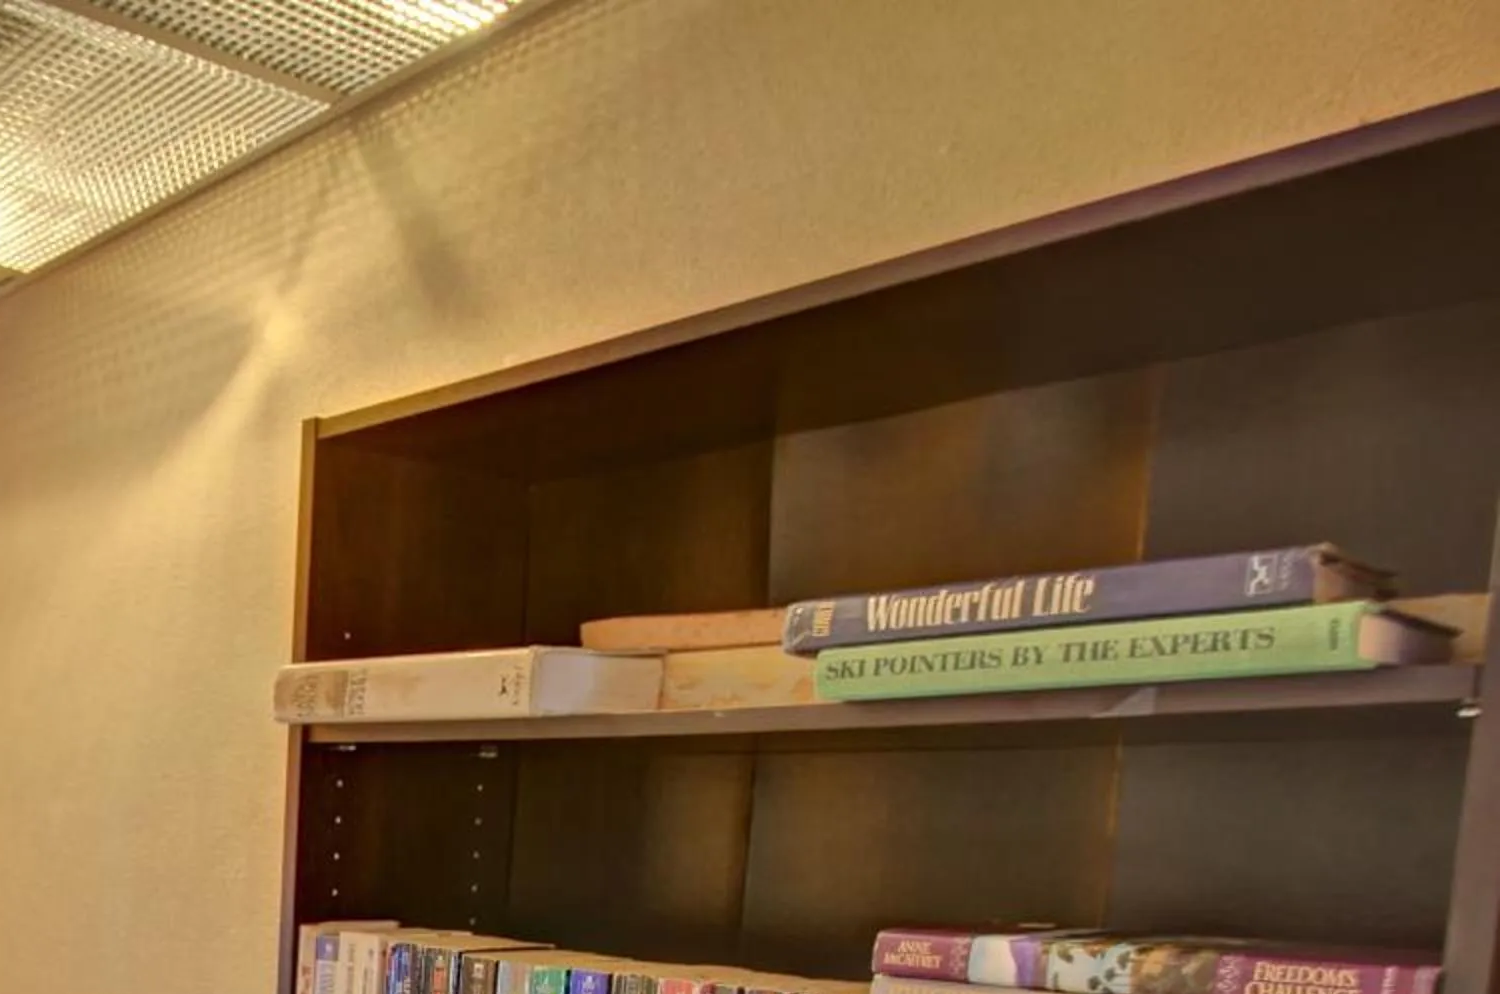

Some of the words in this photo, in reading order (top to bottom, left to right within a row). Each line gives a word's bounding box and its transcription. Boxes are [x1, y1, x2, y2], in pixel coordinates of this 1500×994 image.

[866, 579, 1023, 632] Wonderful
[1033, 574, 1094, 617] Life
[825, 656, 867, 681] SKI
[872, 648, 1001, 676] POINTERS
[1009, 640, 1045, 668] BY
[1058, 637, 1120, 664] THE
[1126, 625, 1275, 659] EXPERTS
